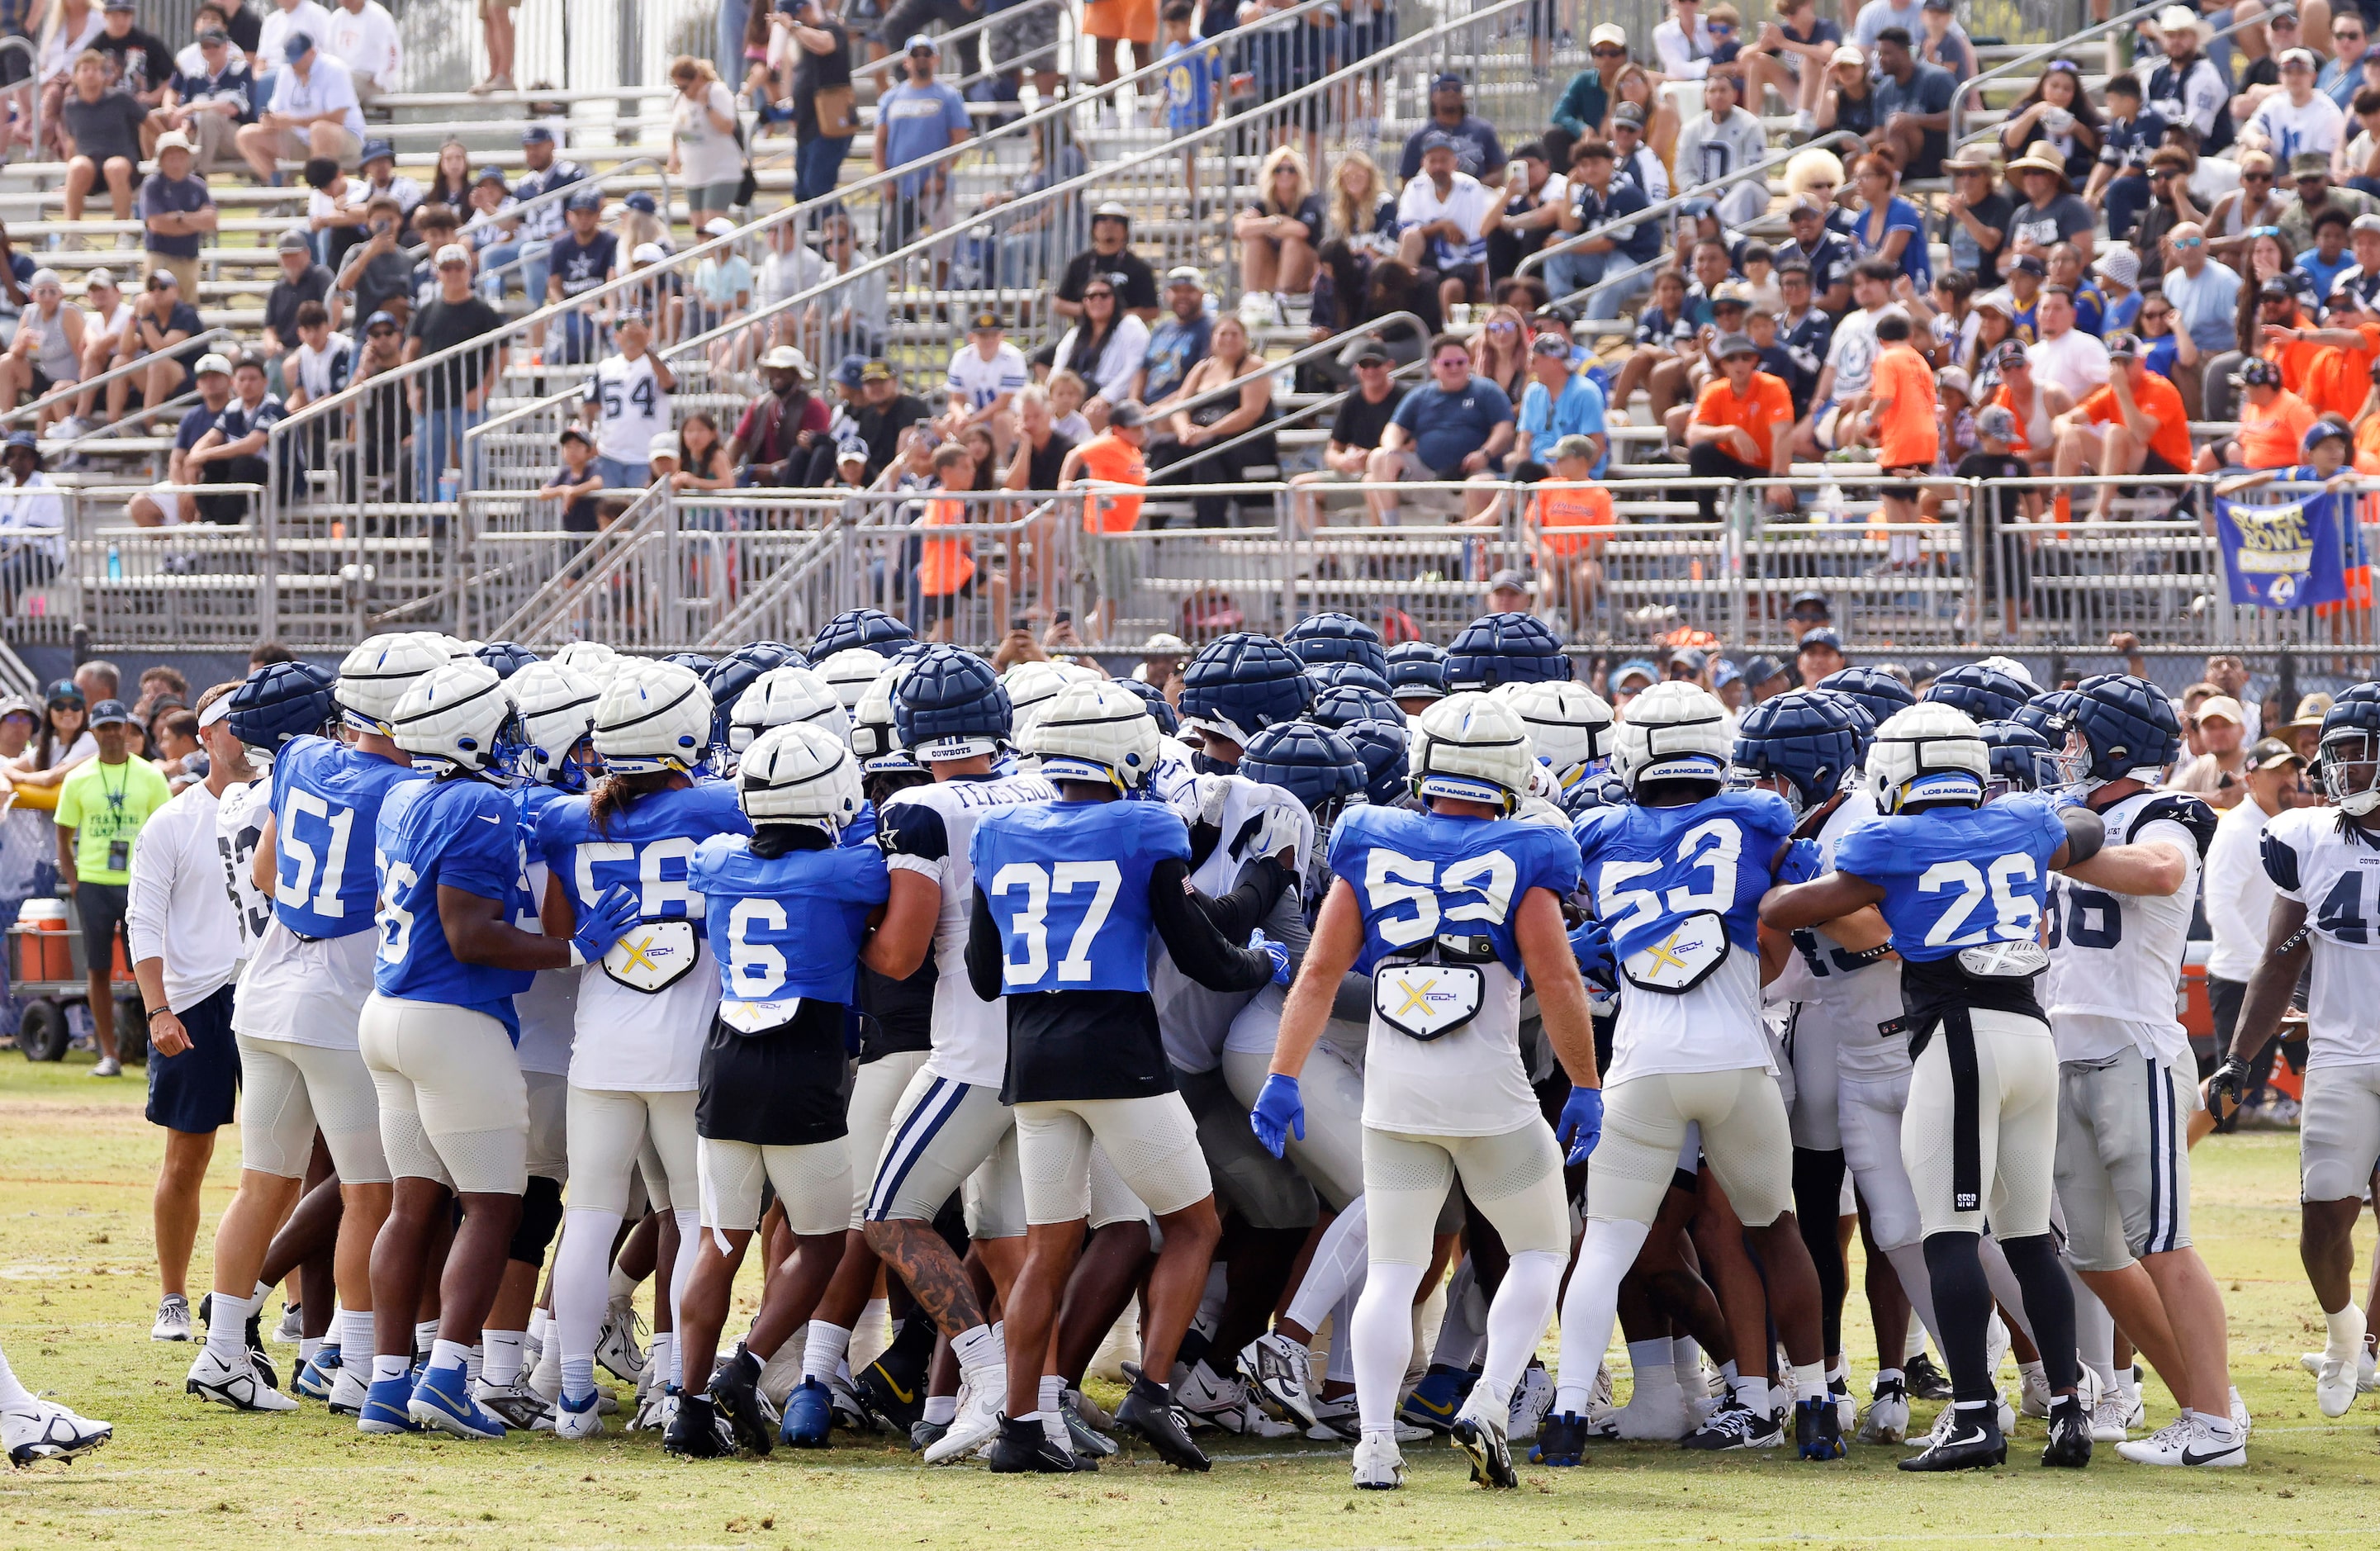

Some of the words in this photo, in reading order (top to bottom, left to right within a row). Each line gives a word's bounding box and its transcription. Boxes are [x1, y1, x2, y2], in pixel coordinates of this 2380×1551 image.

[600, 377, 656, 420] 54
[2228, 504, 2307, 529] SUPER
[2242, 527, 2314, 552] BOWL
[932, 747, 971, 757] COWBOYS
[1447, 787, 1491, 799] ANGELES
[275, 786, 355, 918] 51
[2107, 828, 2121, 836] AT&T
[1364, 847, 1517, 946] 59
[1598, 818, 1742, 941] 53
[1918, 851, 2042, 947] 26
[728, 898, 788, 998] 6
[991, 860, 1122, 985] 37
